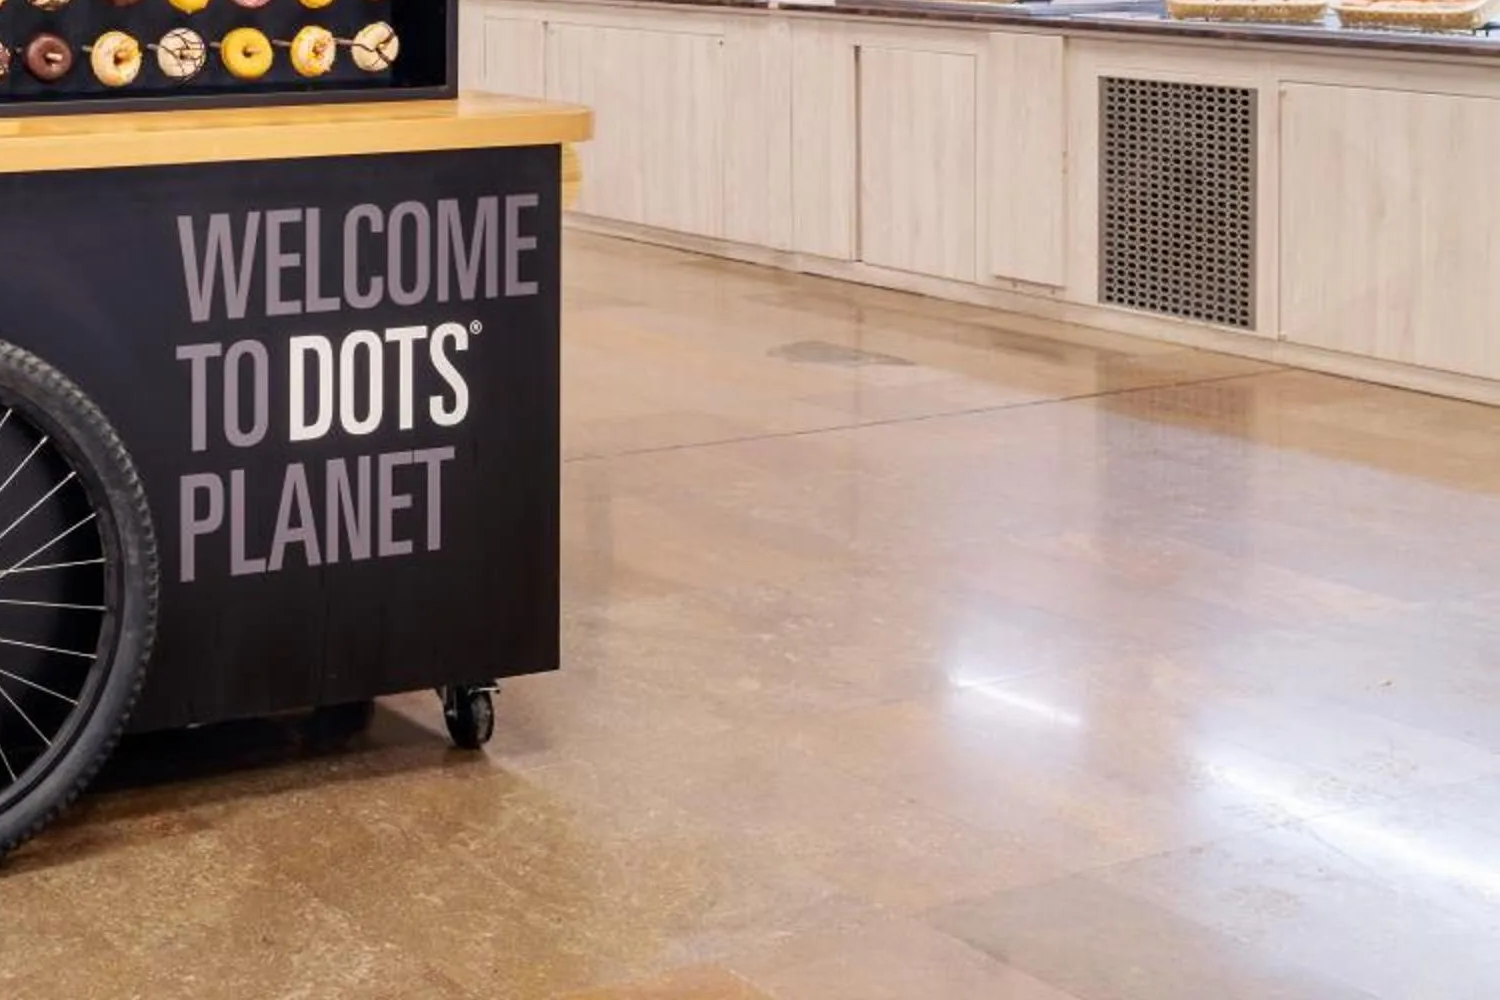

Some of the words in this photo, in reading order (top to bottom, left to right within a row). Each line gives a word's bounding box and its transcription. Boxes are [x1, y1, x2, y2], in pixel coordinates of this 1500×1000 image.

[177, 194, 539, 323] WELCOME
[176, 339, 269, 452] TO
[180, 446, 456, 582] PLANET
